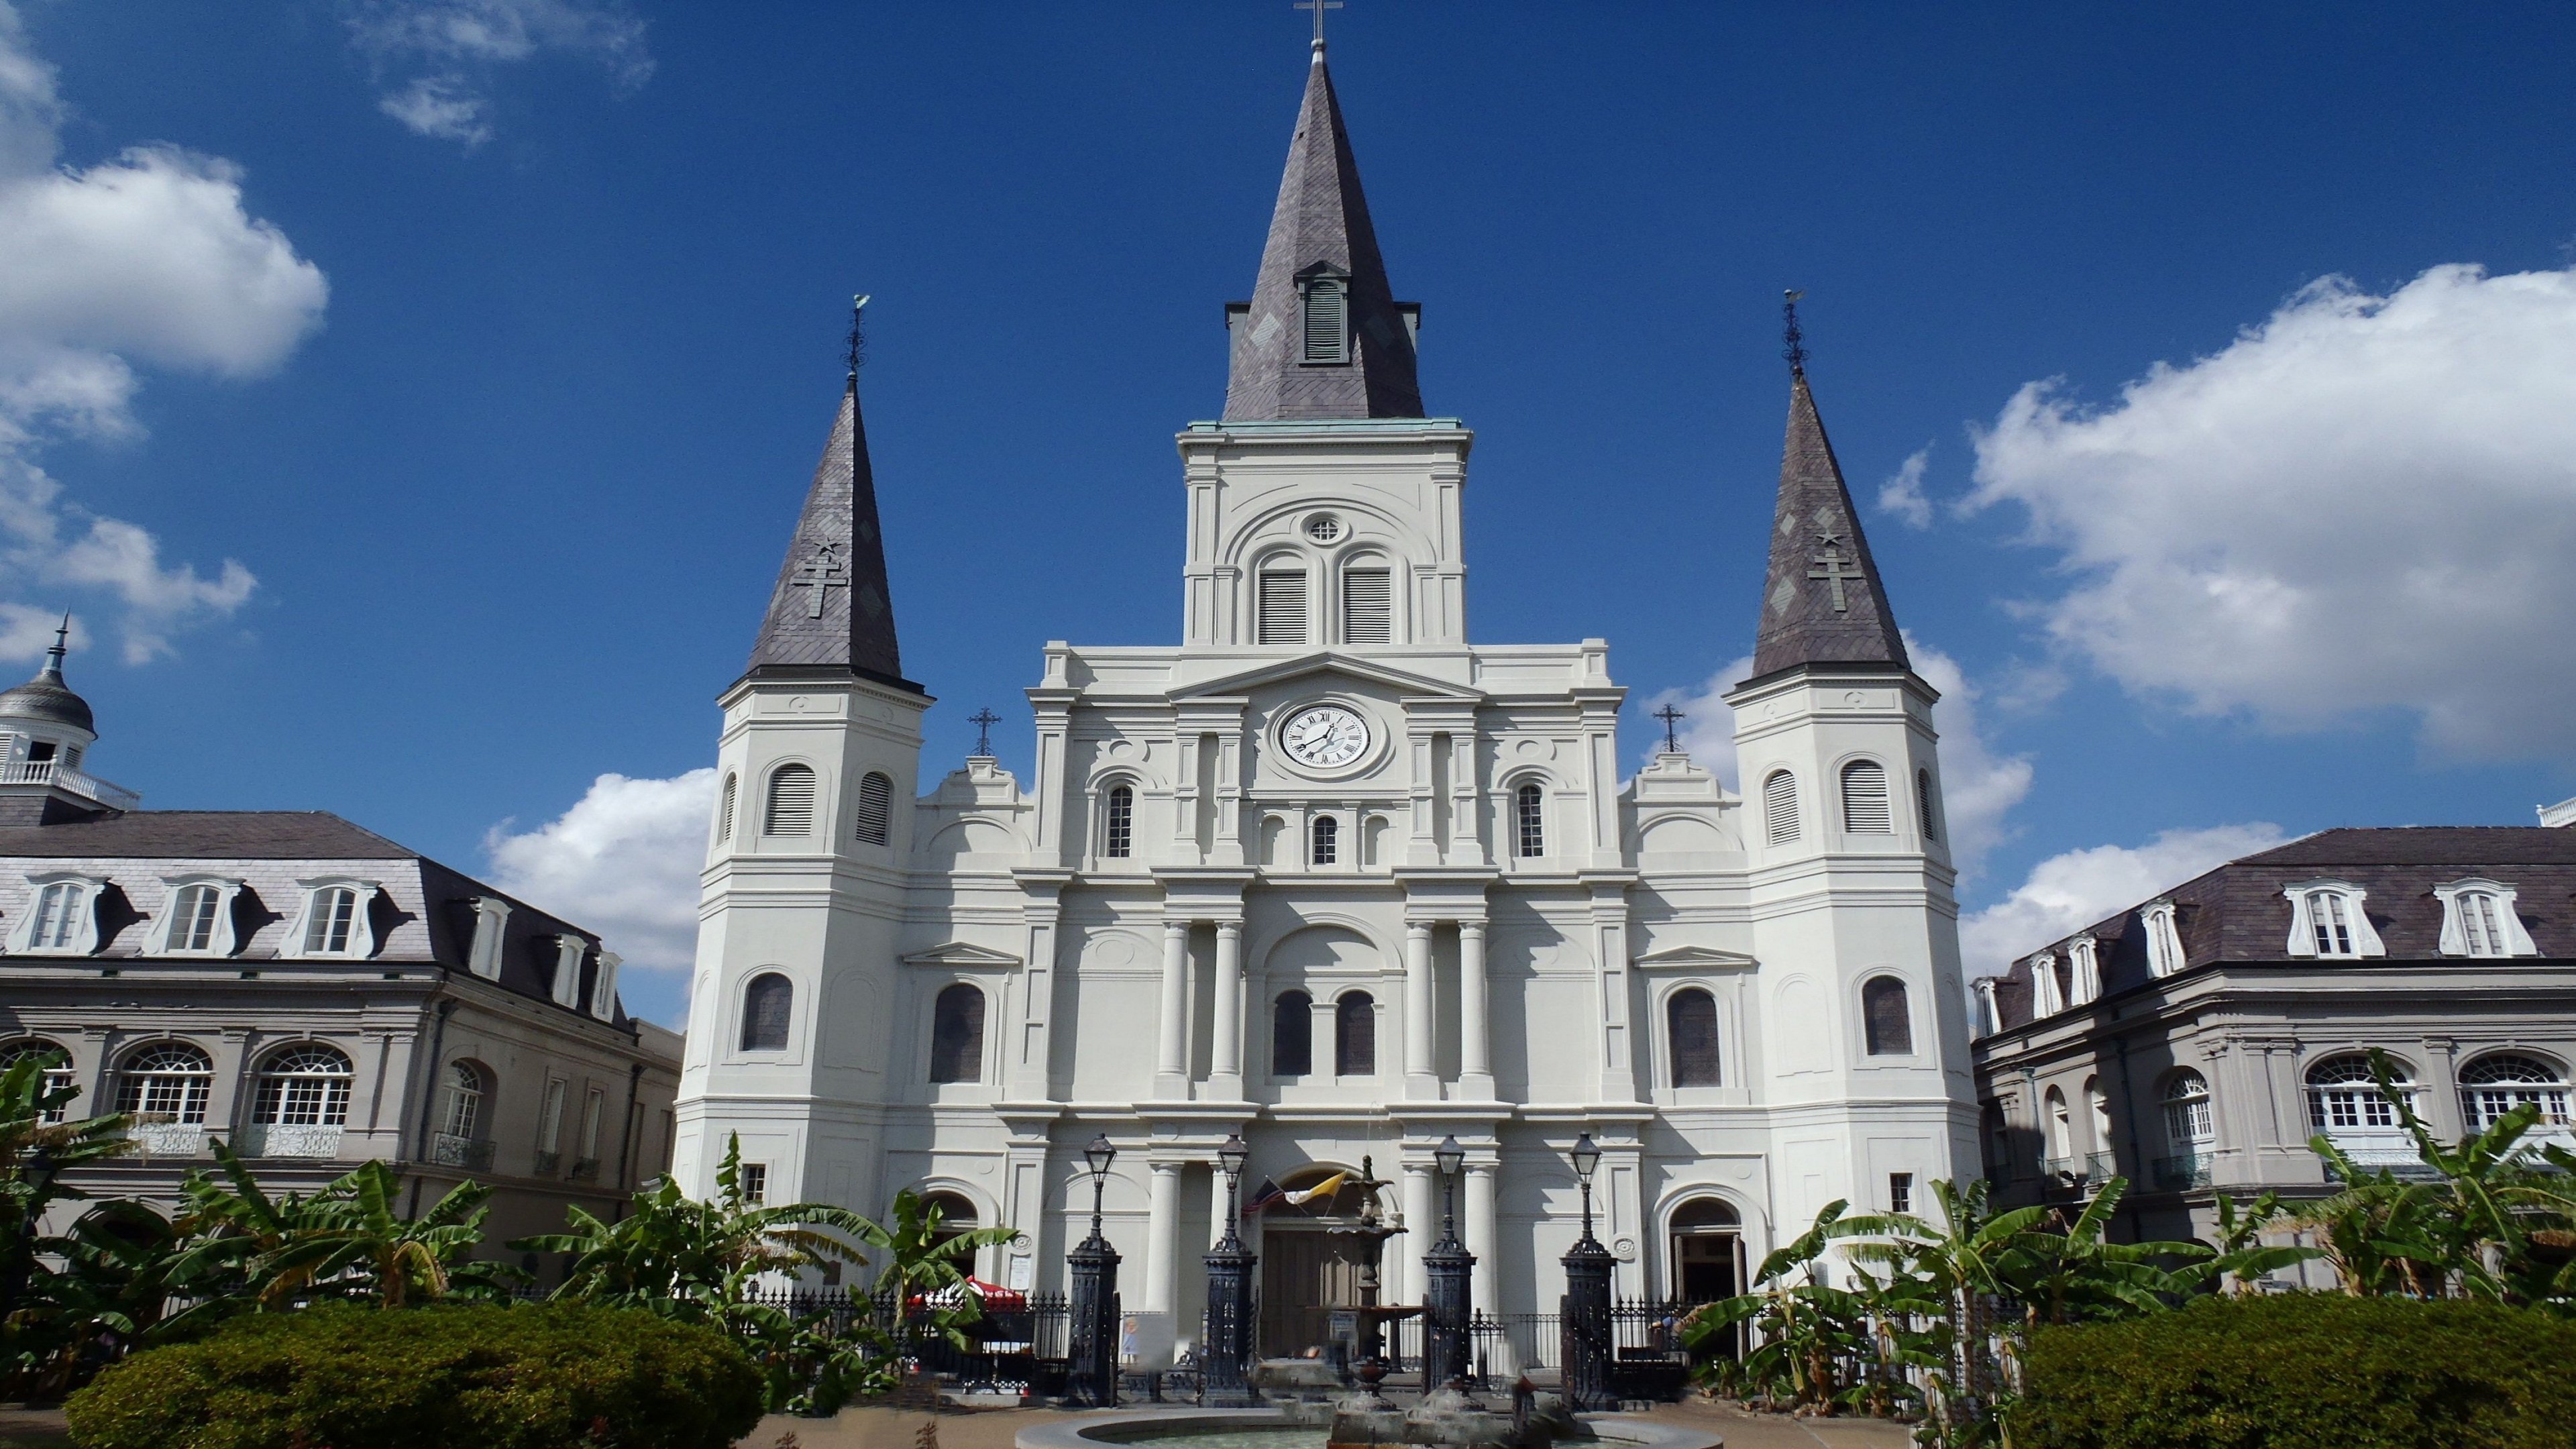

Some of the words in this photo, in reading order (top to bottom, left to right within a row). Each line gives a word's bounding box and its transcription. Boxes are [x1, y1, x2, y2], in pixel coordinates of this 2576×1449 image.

[1307, 716, 1316, 724] XI
[1320, 713, 1330, 722] XII
[1320, 754, 1328, 763] VI
